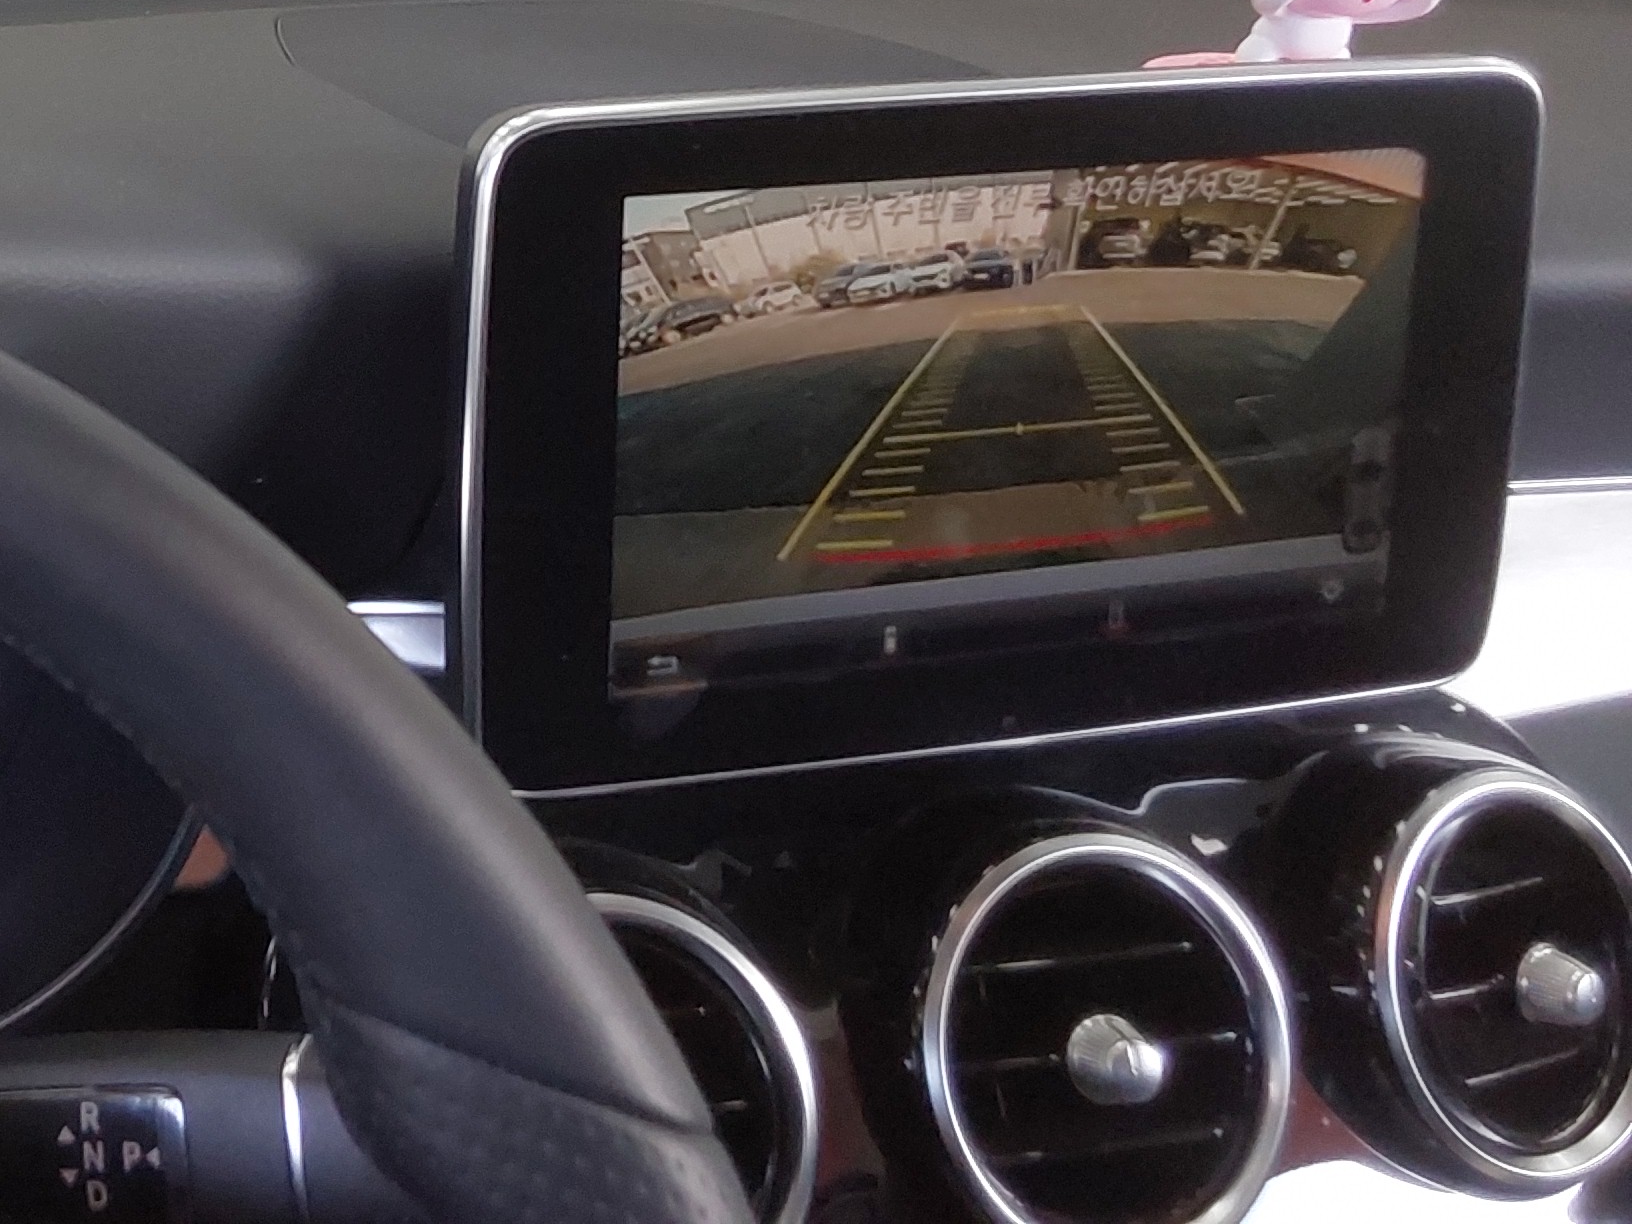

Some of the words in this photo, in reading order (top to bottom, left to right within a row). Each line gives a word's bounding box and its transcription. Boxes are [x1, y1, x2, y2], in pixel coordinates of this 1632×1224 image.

[806, 193, 875, 231] 차량
[882, 185, 982, 226] 주변을
[80, 1101, 100, 1132] R
[83, 1140, 105, 1173] N
[123, 1140, 141, 1173] P
[86, 1179, 108, 1211] D
